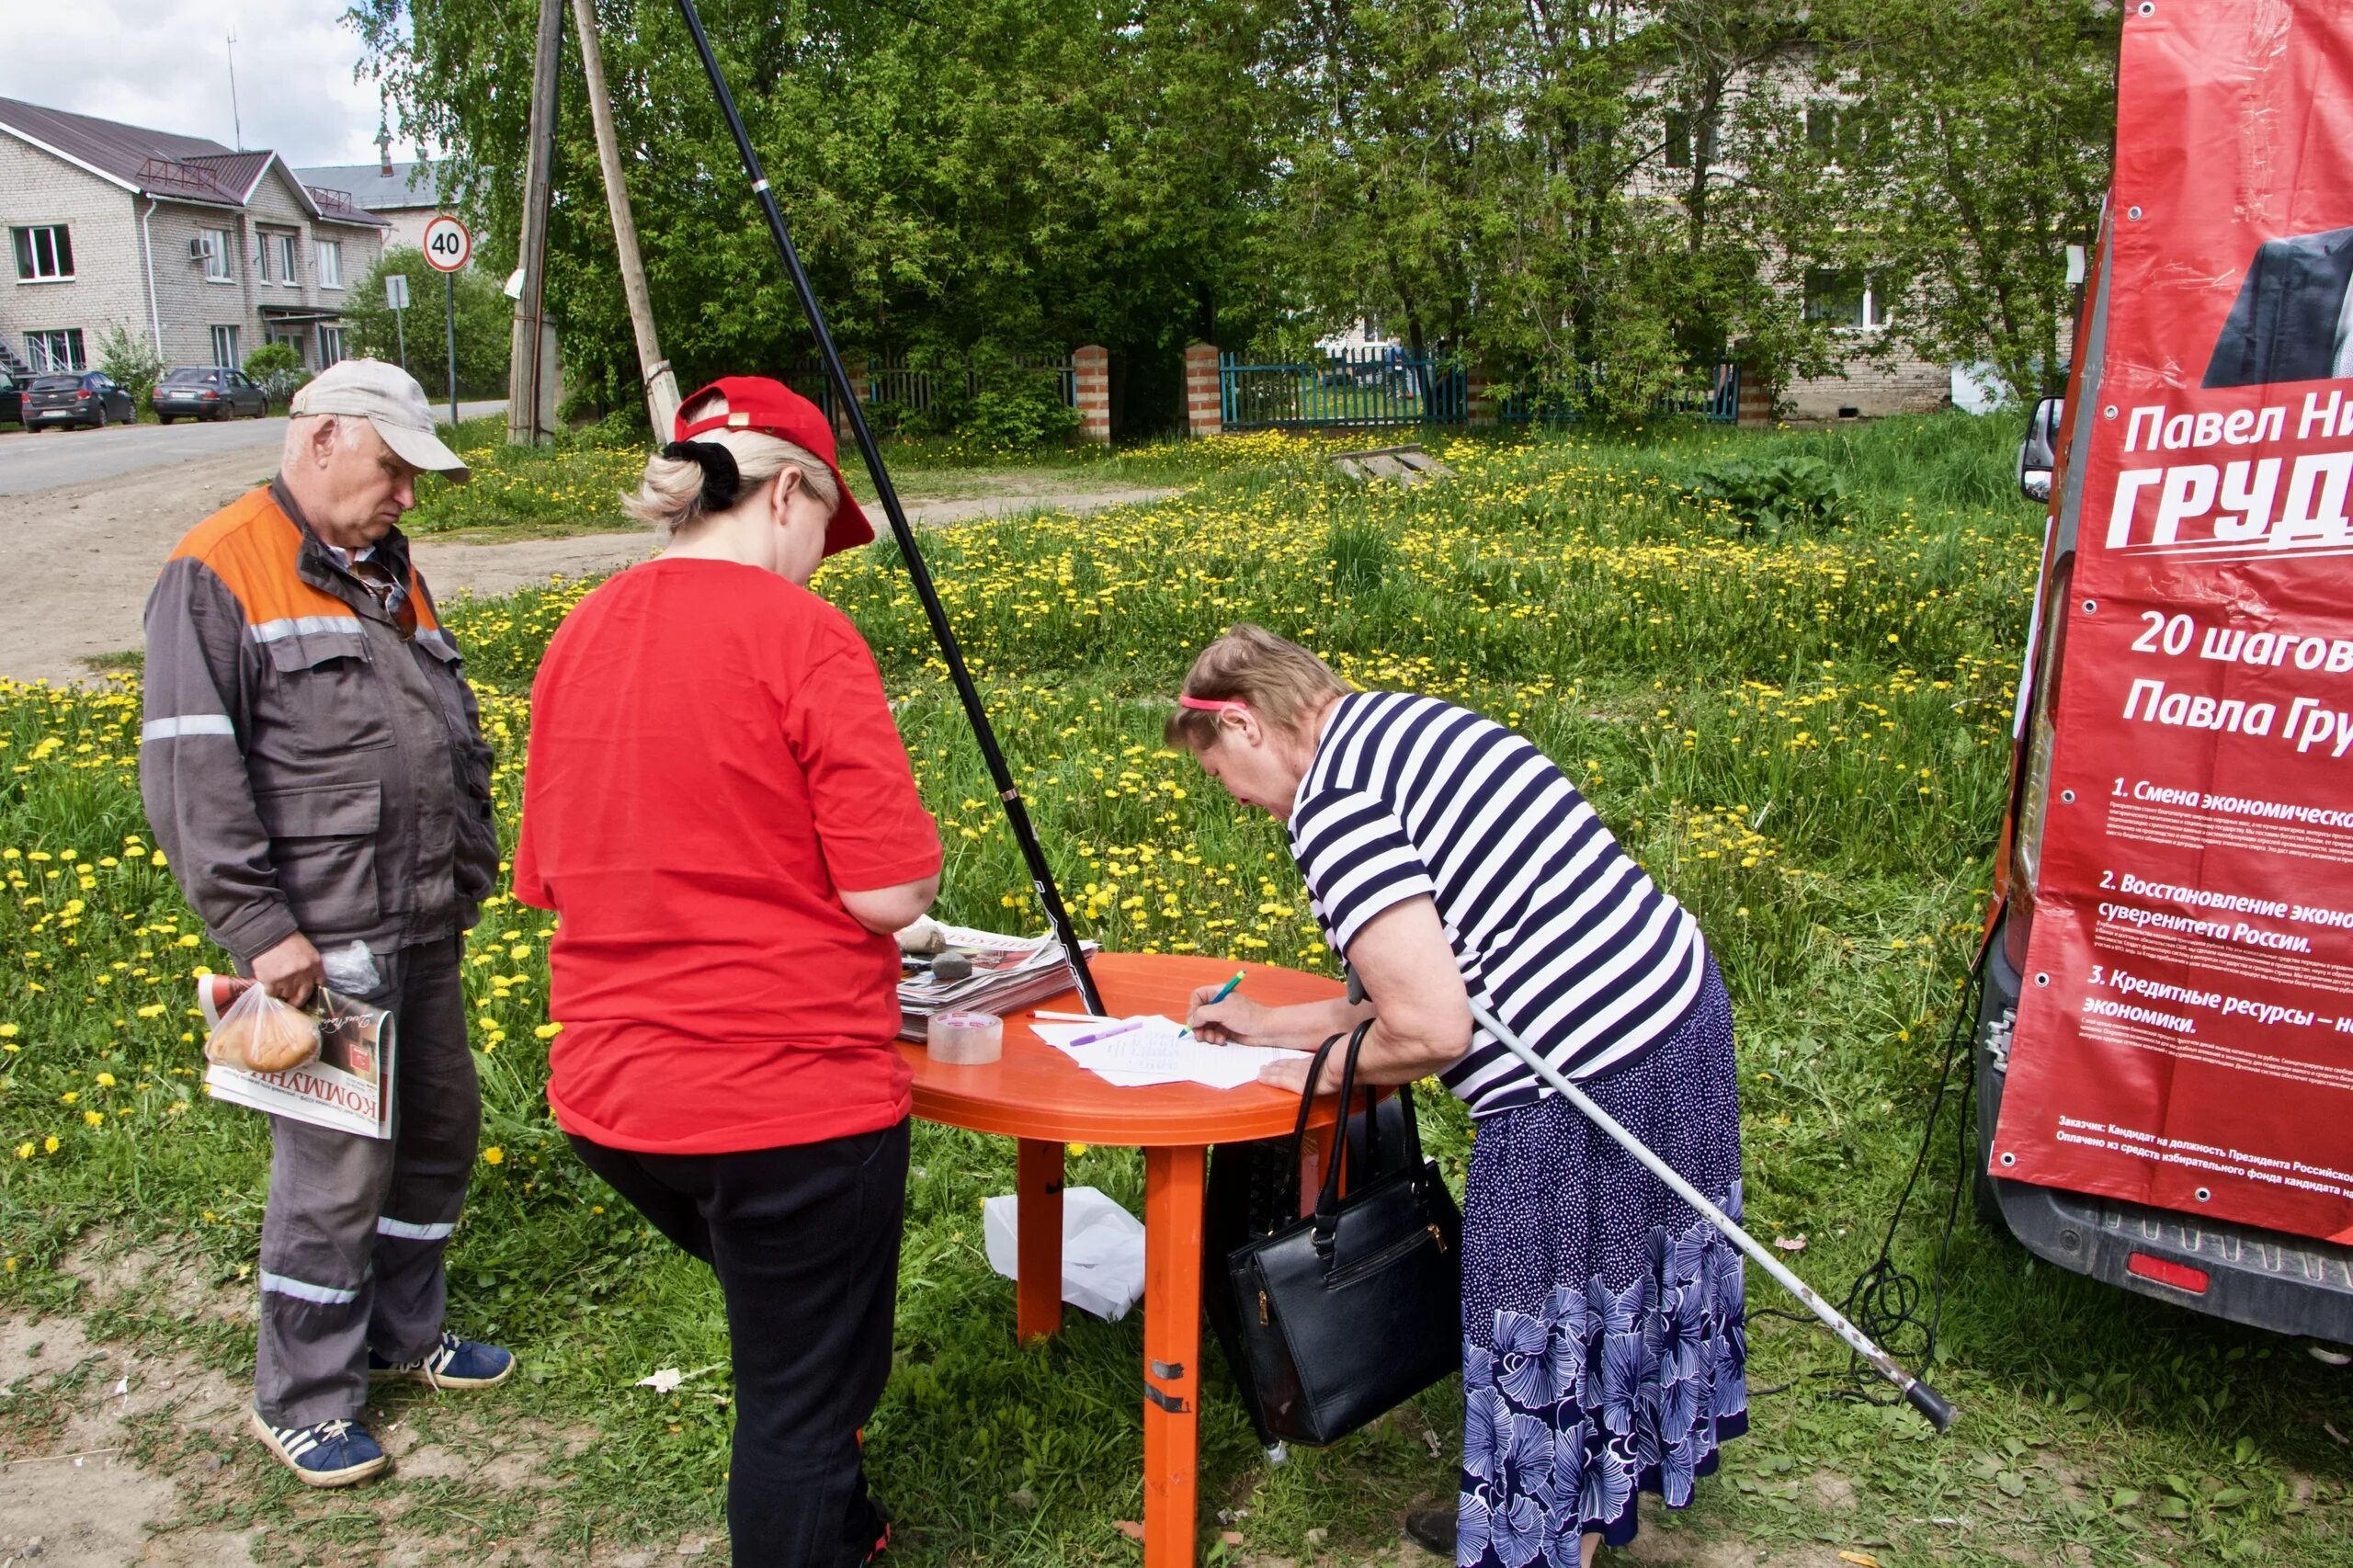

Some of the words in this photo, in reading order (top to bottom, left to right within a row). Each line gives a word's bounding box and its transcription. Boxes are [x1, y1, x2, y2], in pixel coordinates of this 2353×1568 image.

[432, 233, 460, 255] 40
[2123, 405, 2286, 452] Павел
[2105, 452, 2353, 551] ГРУД
[2131, 610, 2196, 656] 20
[2200, 627, 2353, 673] шагов
[2122, 678, 2276, 736] Павла
[2282, 697, 2353, 757] Гру
[2111, 777, 2129, 797] 1.
[2133, 780, 2200, 807] Смена
[2200, 792, 2353, 828] экономическо
[2098, 869, 2117, 891] 2.
[2120, 873, 2288, 918] Восстановление
[2289, 904, 2353, 928] эконо
[2098, 902, 2230, 939] суверенитета
[2232, 922, 2312, 953] России.
[2082, 997, 2197, 1034] экономики.
[2087, 964, 2106, 985] 3.
[2109, 969, 2222, 1008] Кредитные
[2222, 996, 2314, 1026] ресурсы
[2055, 1130, 2106, 1148] Оплачено
[2107, 1140, 2119, 1151] из
[2120, 1142, 2161, 1160] средств
[2161, 1152, 2245, 1176] избирательного
[2246, 1167, 2282, 1185] фонда
[2284, 1176, 2341, 1196] кандидата
[2058, 1115, 2106, 1132] Заказчик:
[2108, 1123, 2156, 1143] Кандидат
[2157, 1136, 2168, 1147] на
[2169, 1139, 2226, 1157] должность
[2228, 1148, 2291, 1170] Президента
